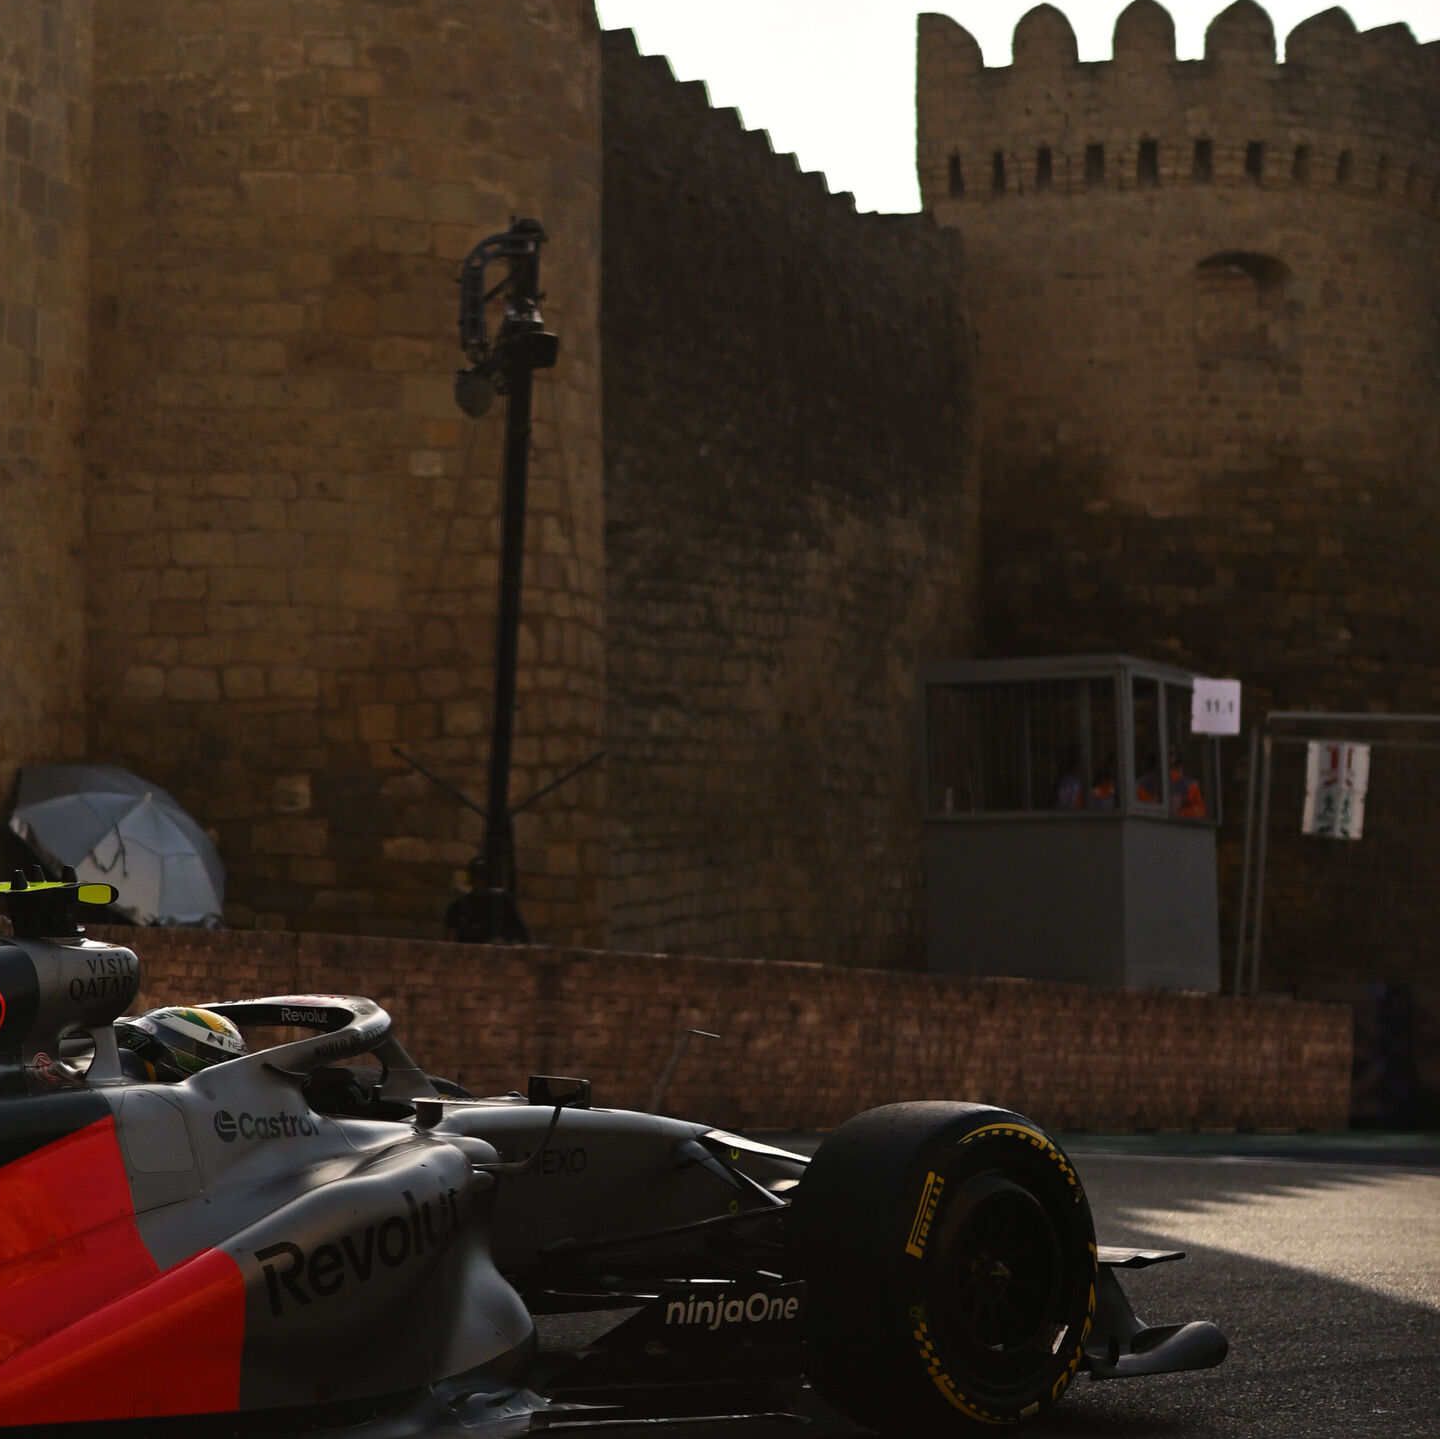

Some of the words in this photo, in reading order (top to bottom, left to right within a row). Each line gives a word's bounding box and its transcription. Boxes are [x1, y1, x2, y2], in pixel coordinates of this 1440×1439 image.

[86, 952, 134, 975] visit
[69, 975, 134, 1002] QATAR
[280, 1007, 329, 1024] Revolut
[238, 1110, 320, 1140] Castrol
[904, 1170, 945, 1260] PIRELLI
[254, 1187, 459, 1318] Revolut
[665, 1291, 800, 1332] ninjaOne
